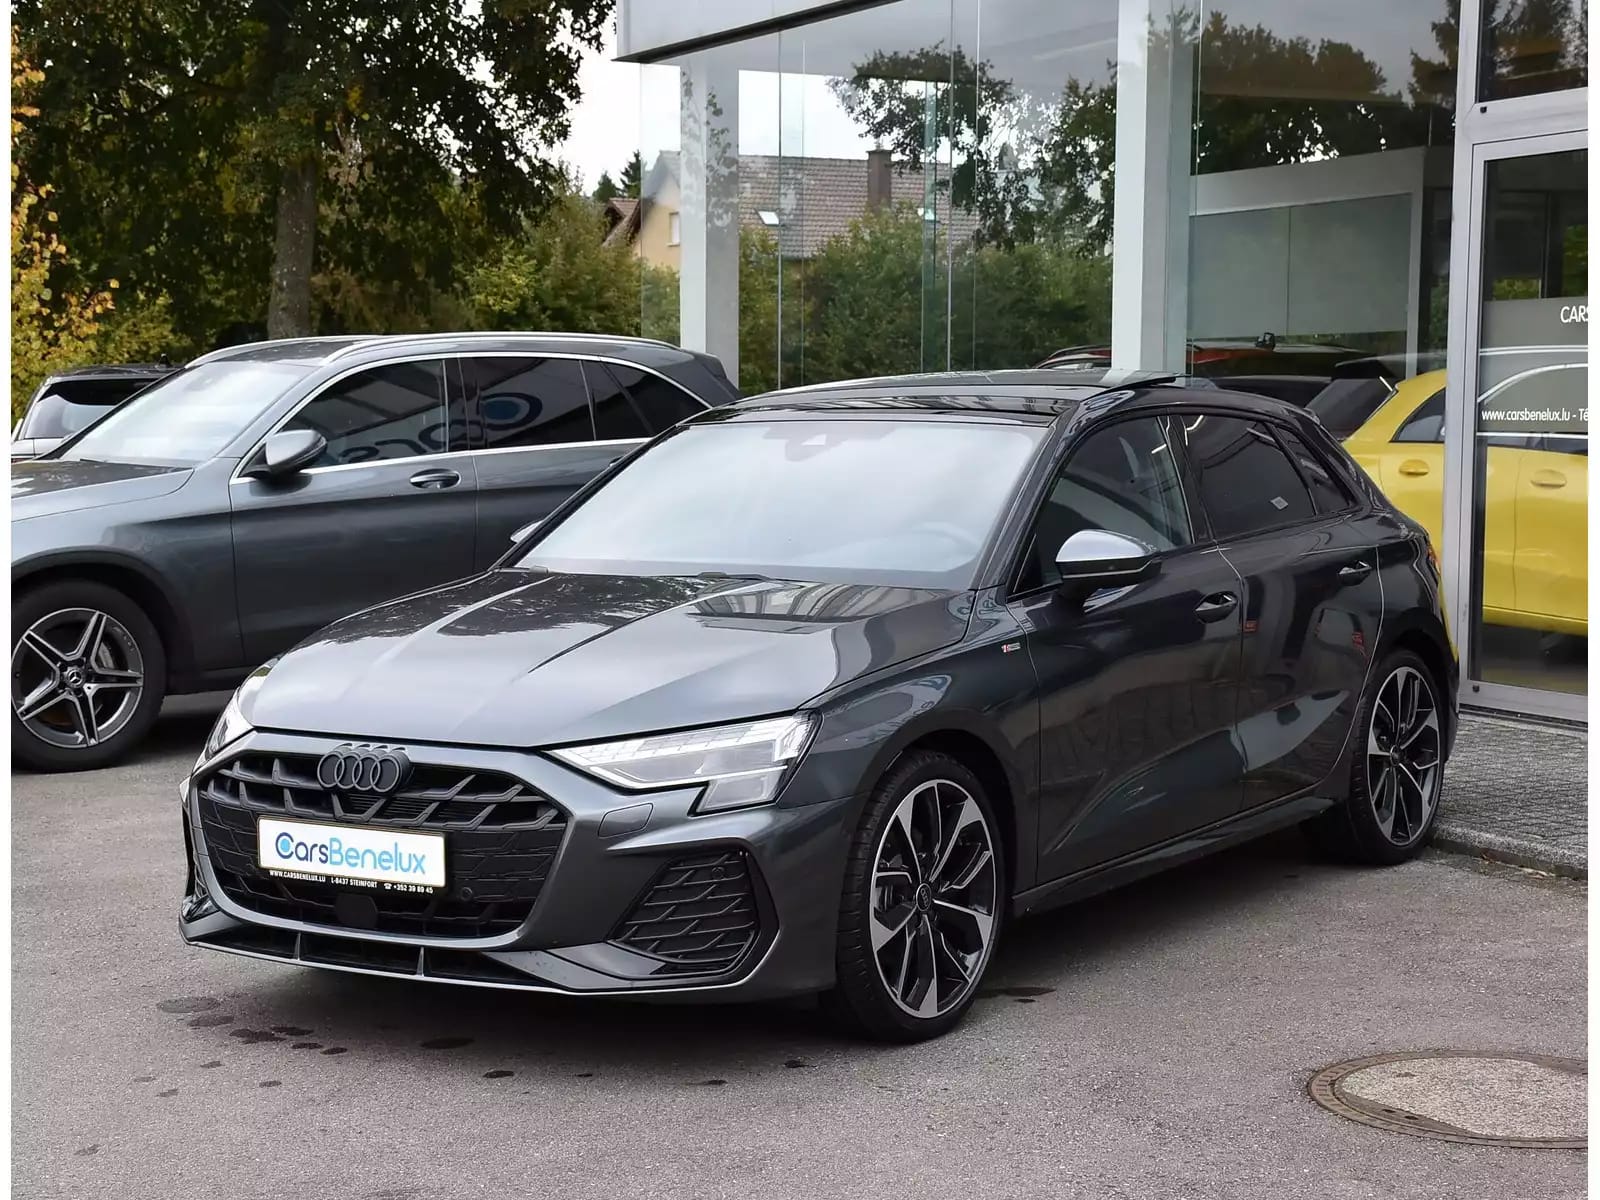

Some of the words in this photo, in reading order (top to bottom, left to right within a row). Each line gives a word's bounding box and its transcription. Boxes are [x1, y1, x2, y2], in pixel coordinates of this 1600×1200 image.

[1560, 305, 1588, 323] CAR
[1482, 407, 1570, 421] www.carsbenelux.lu
[275, 832, 426, 874] CarsBenelux
[269, 870, 326, 882] WWW.CARSBENELUX.LU
[349, 878, 378, 888] STEINFORT
